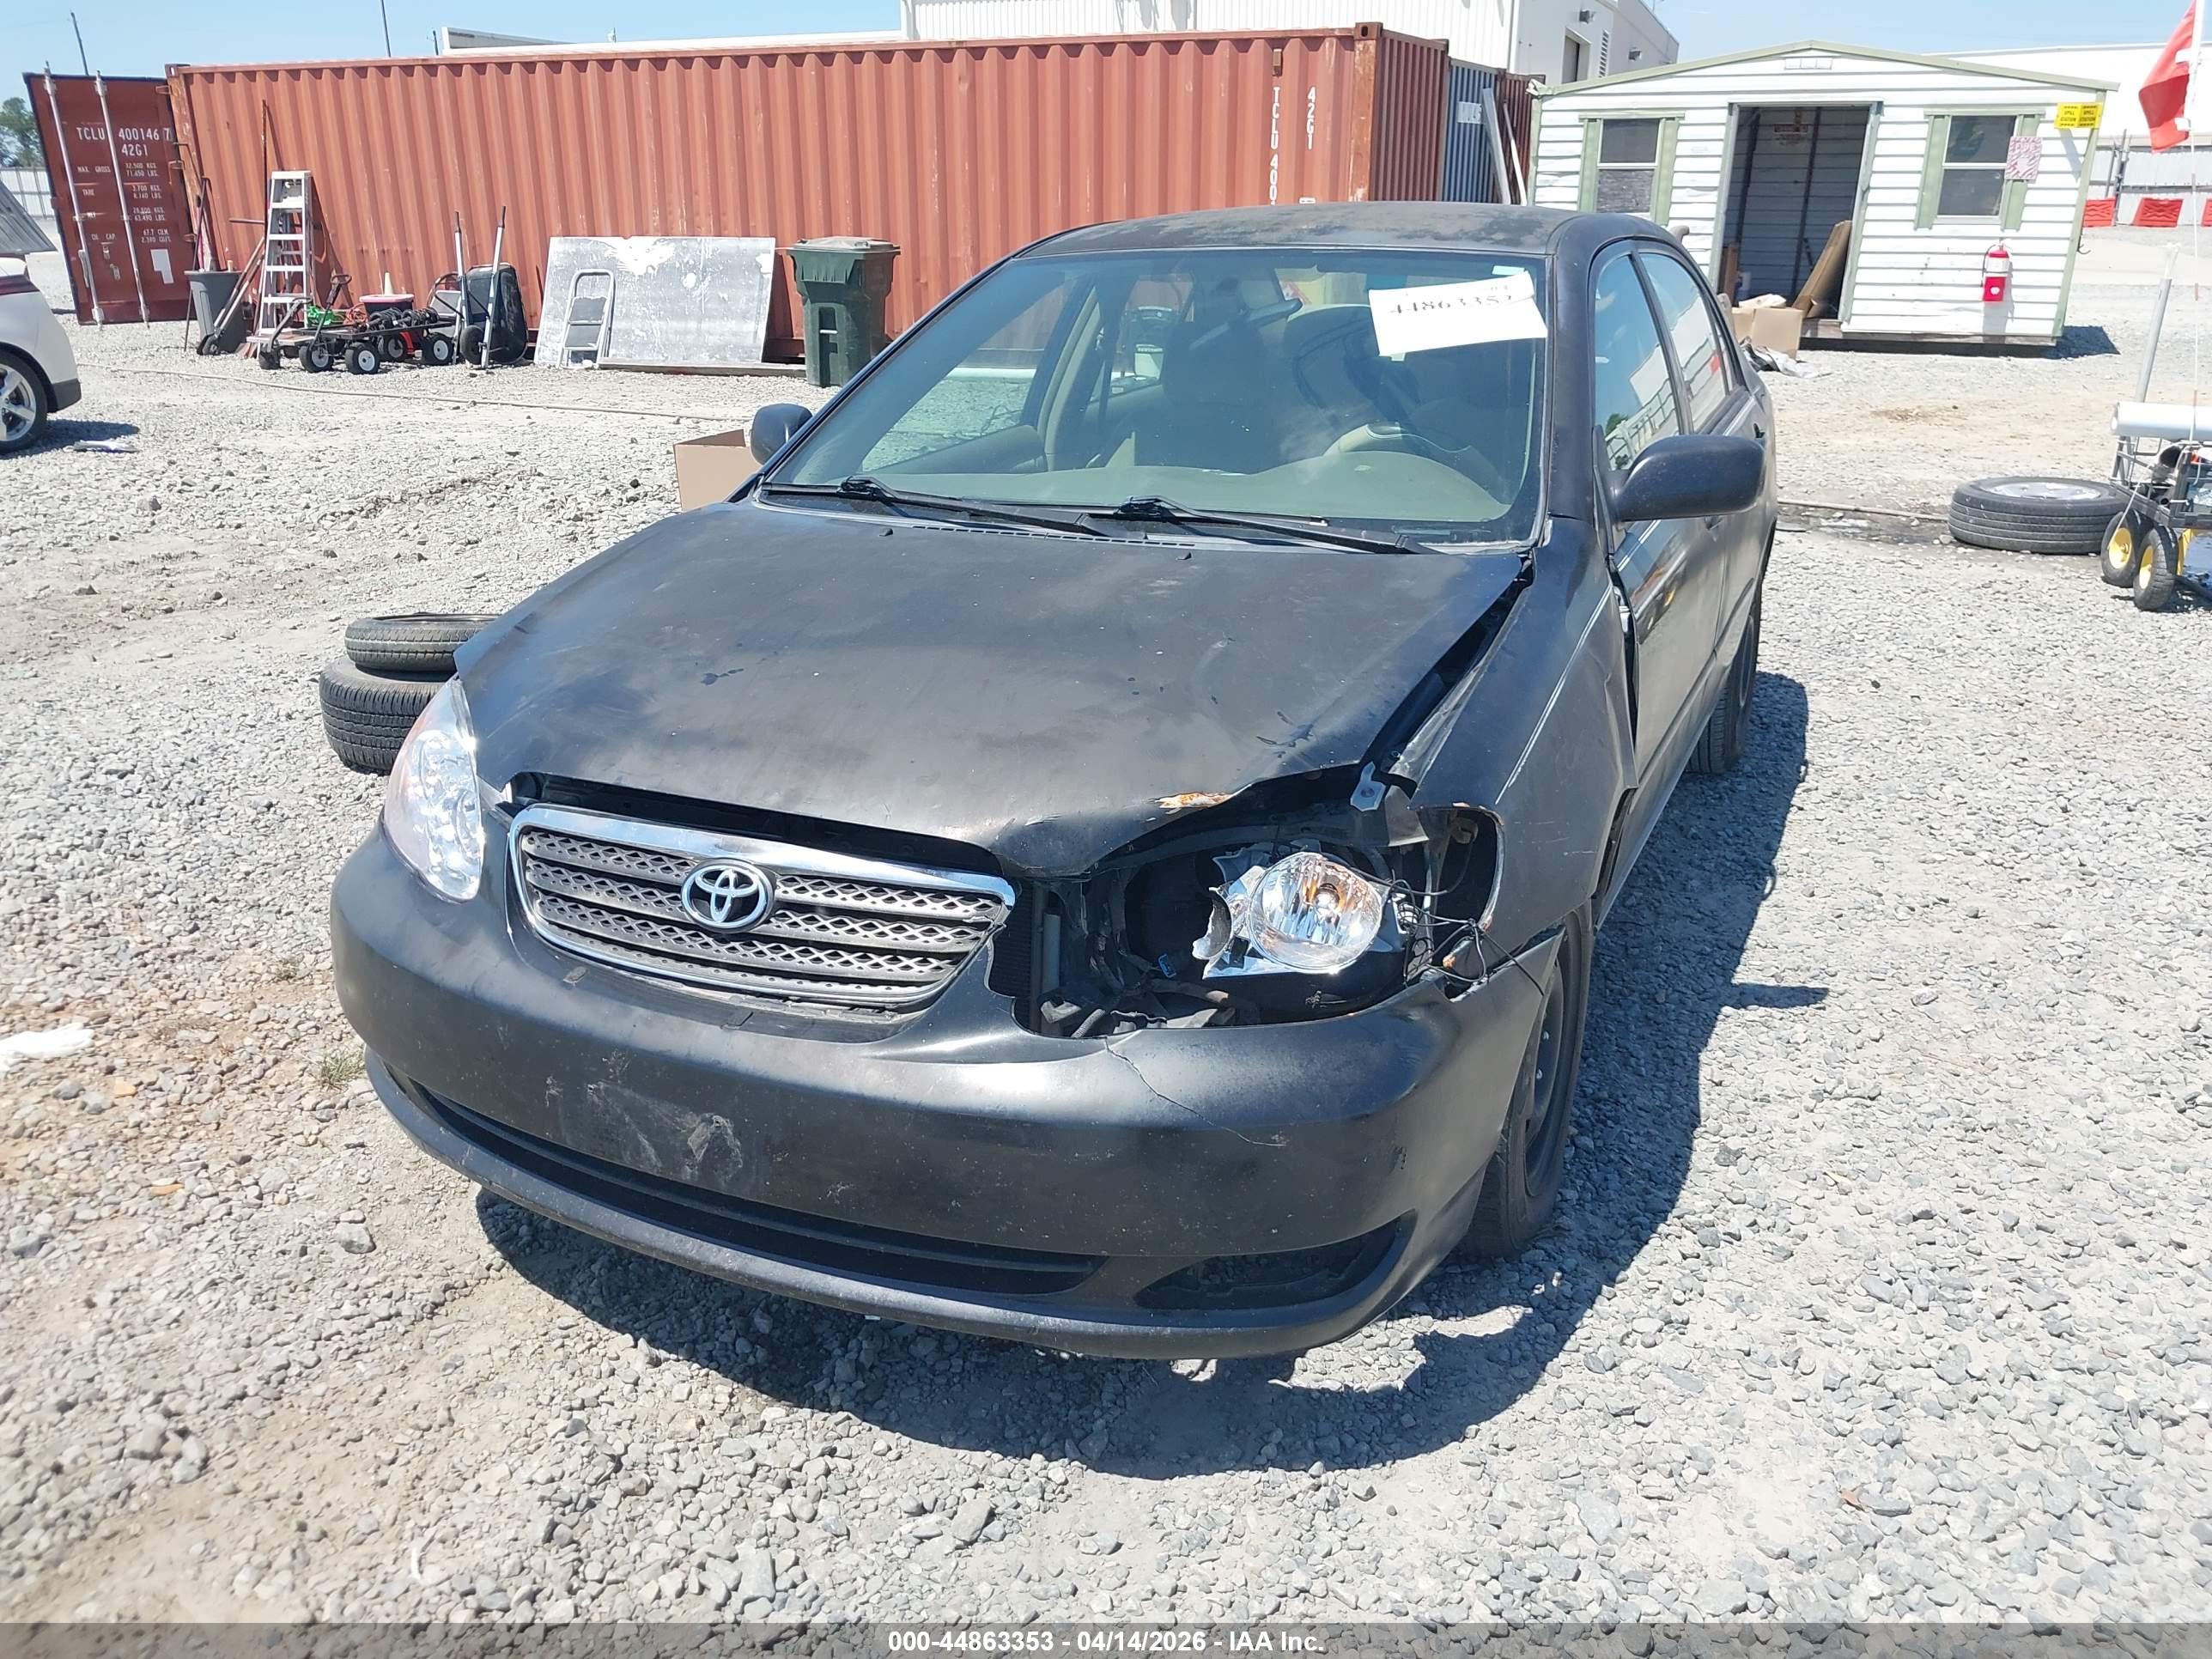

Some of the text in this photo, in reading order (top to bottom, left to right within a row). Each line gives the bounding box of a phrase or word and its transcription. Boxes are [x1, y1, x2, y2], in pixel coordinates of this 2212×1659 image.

[76, 127, 106, 140] TCLU
[118, 127, 160, 141] 400146
[1271, 87, 1280, 149] TCLU
[1306, 87, 1316, 149] 42G1
[121, 143, 149, 156] 42G1
